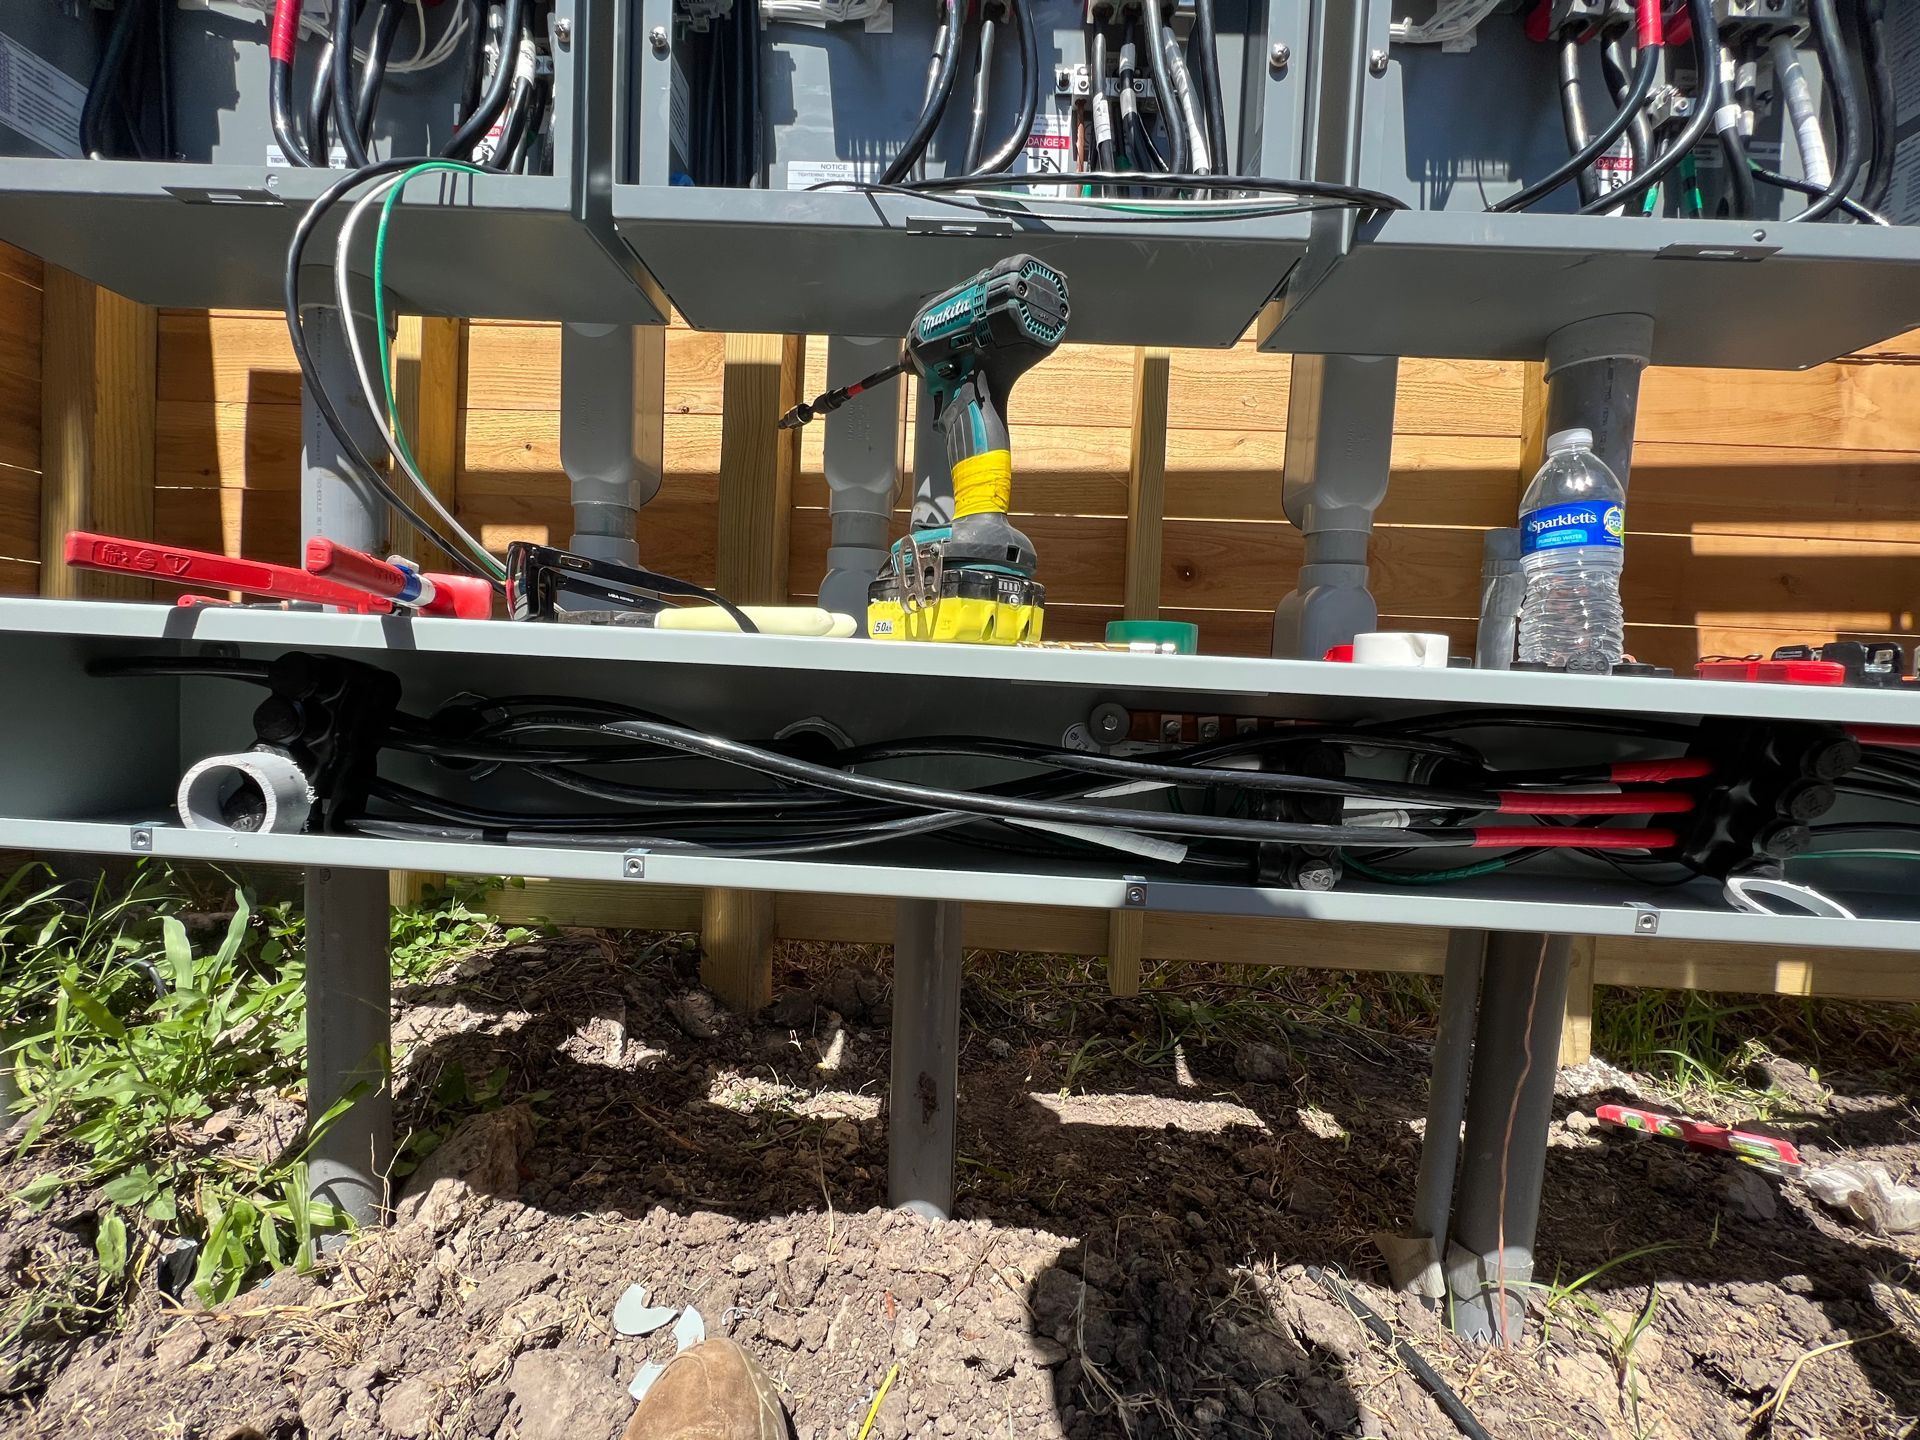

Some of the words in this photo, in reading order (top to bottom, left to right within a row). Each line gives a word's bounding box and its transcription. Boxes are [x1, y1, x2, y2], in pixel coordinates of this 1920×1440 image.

[1027, 137, 1066, 147] DANGER
[820, 163, 848, 171] NOTICE
[922, 299, 972, 331] Makita
[1531, 512, 1597, 534] Sparkletts
[1562, 533, 1583, 541] WATER
